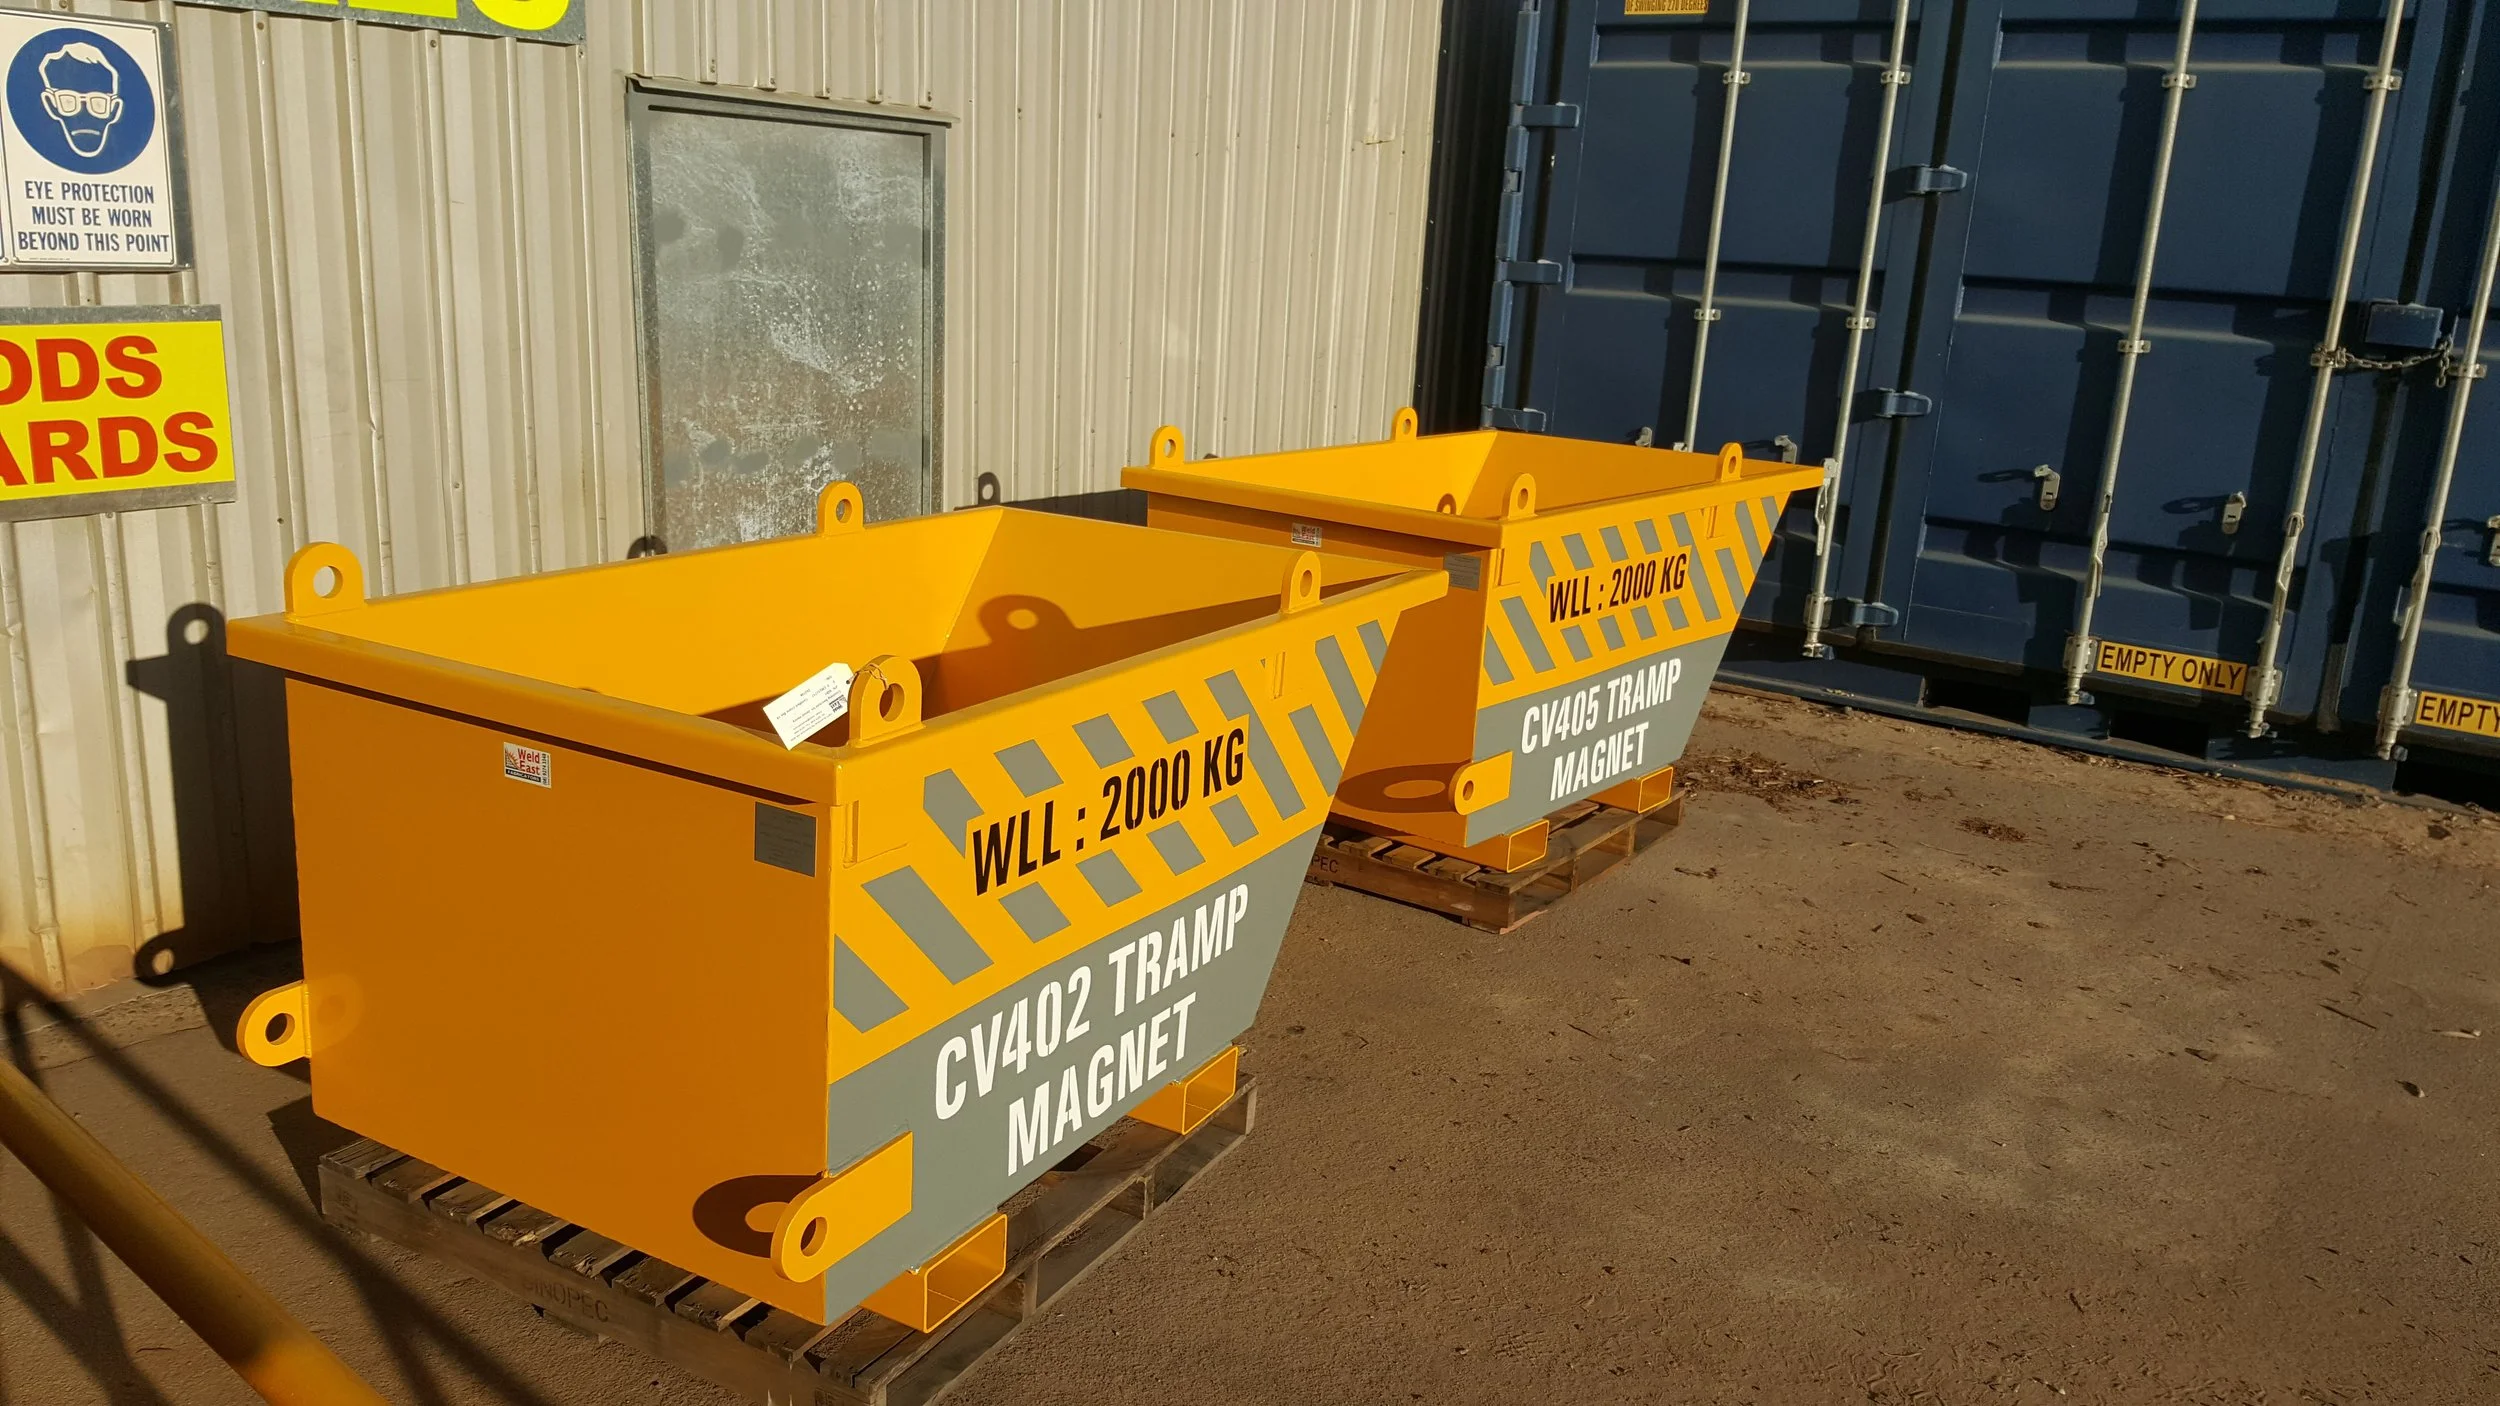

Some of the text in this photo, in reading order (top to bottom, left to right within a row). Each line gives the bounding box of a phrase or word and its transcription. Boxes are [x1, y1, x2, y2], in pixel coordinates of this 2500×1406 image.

[25, 180, 154, 204] EYE PROTECTION
[32, 206, 152, 228] MUST BE WORN
[18, 231, 169, 252] BEYOND THIS POINT
[1550, 575, 1591, 623] WLL
[1609, 559, 1656, 608] 2000
[1659, 553, 1687, 594] KG
[2101, 645, 2243, 690] EMPTY ONLY
[1521, 658, 1681, 754] CV405 TRAMP
[518, 748, 540, 764] Weld
[519, 760, 540, 775] East
[1550, 721, 1649, 802] MAGNET
[973, 800, 1061, 896] WLL
[1100, 749, 1190, 841] 2000
[1203, 728, 1244, 798] KG
[935, 883, 1249, 1120] CV402 TRAMP
[1008, 991, 1197, 1177] MAGNET
